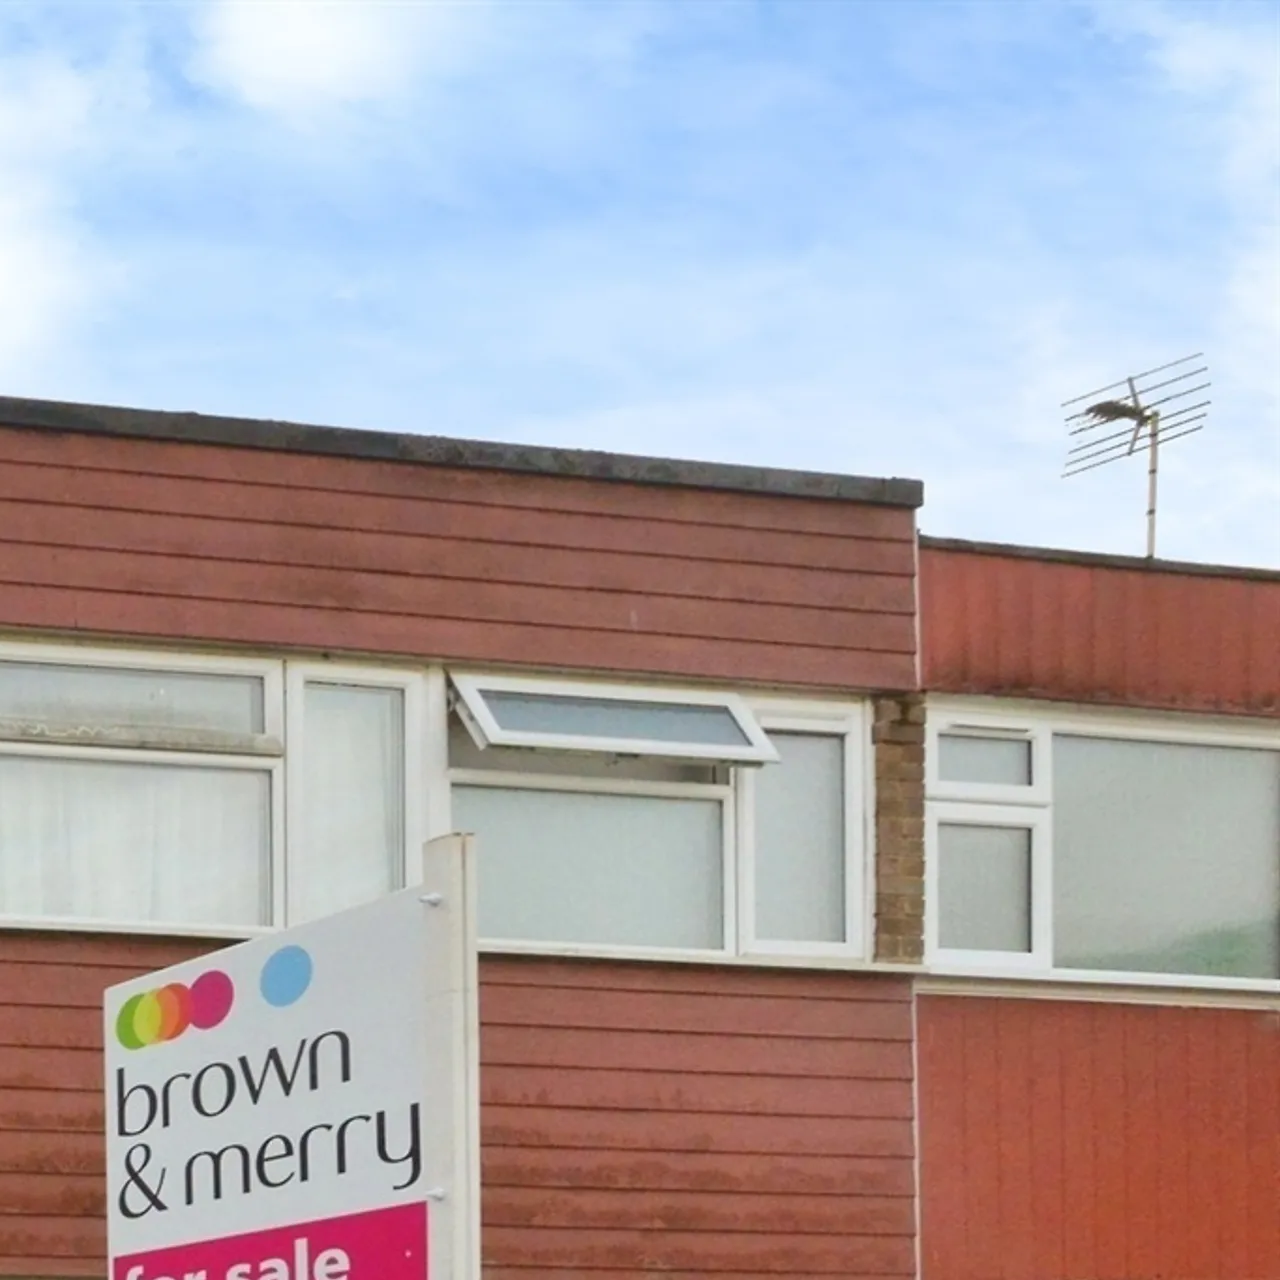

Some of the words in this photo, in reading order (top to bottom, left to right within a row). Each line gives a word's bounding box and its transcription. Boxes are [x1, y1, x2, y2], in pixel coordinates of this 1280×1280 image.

[116, 1029, 352, 1137] brown
[118, 1143, 169, 1220] &
[184, 1102, 422, 1205] merry
